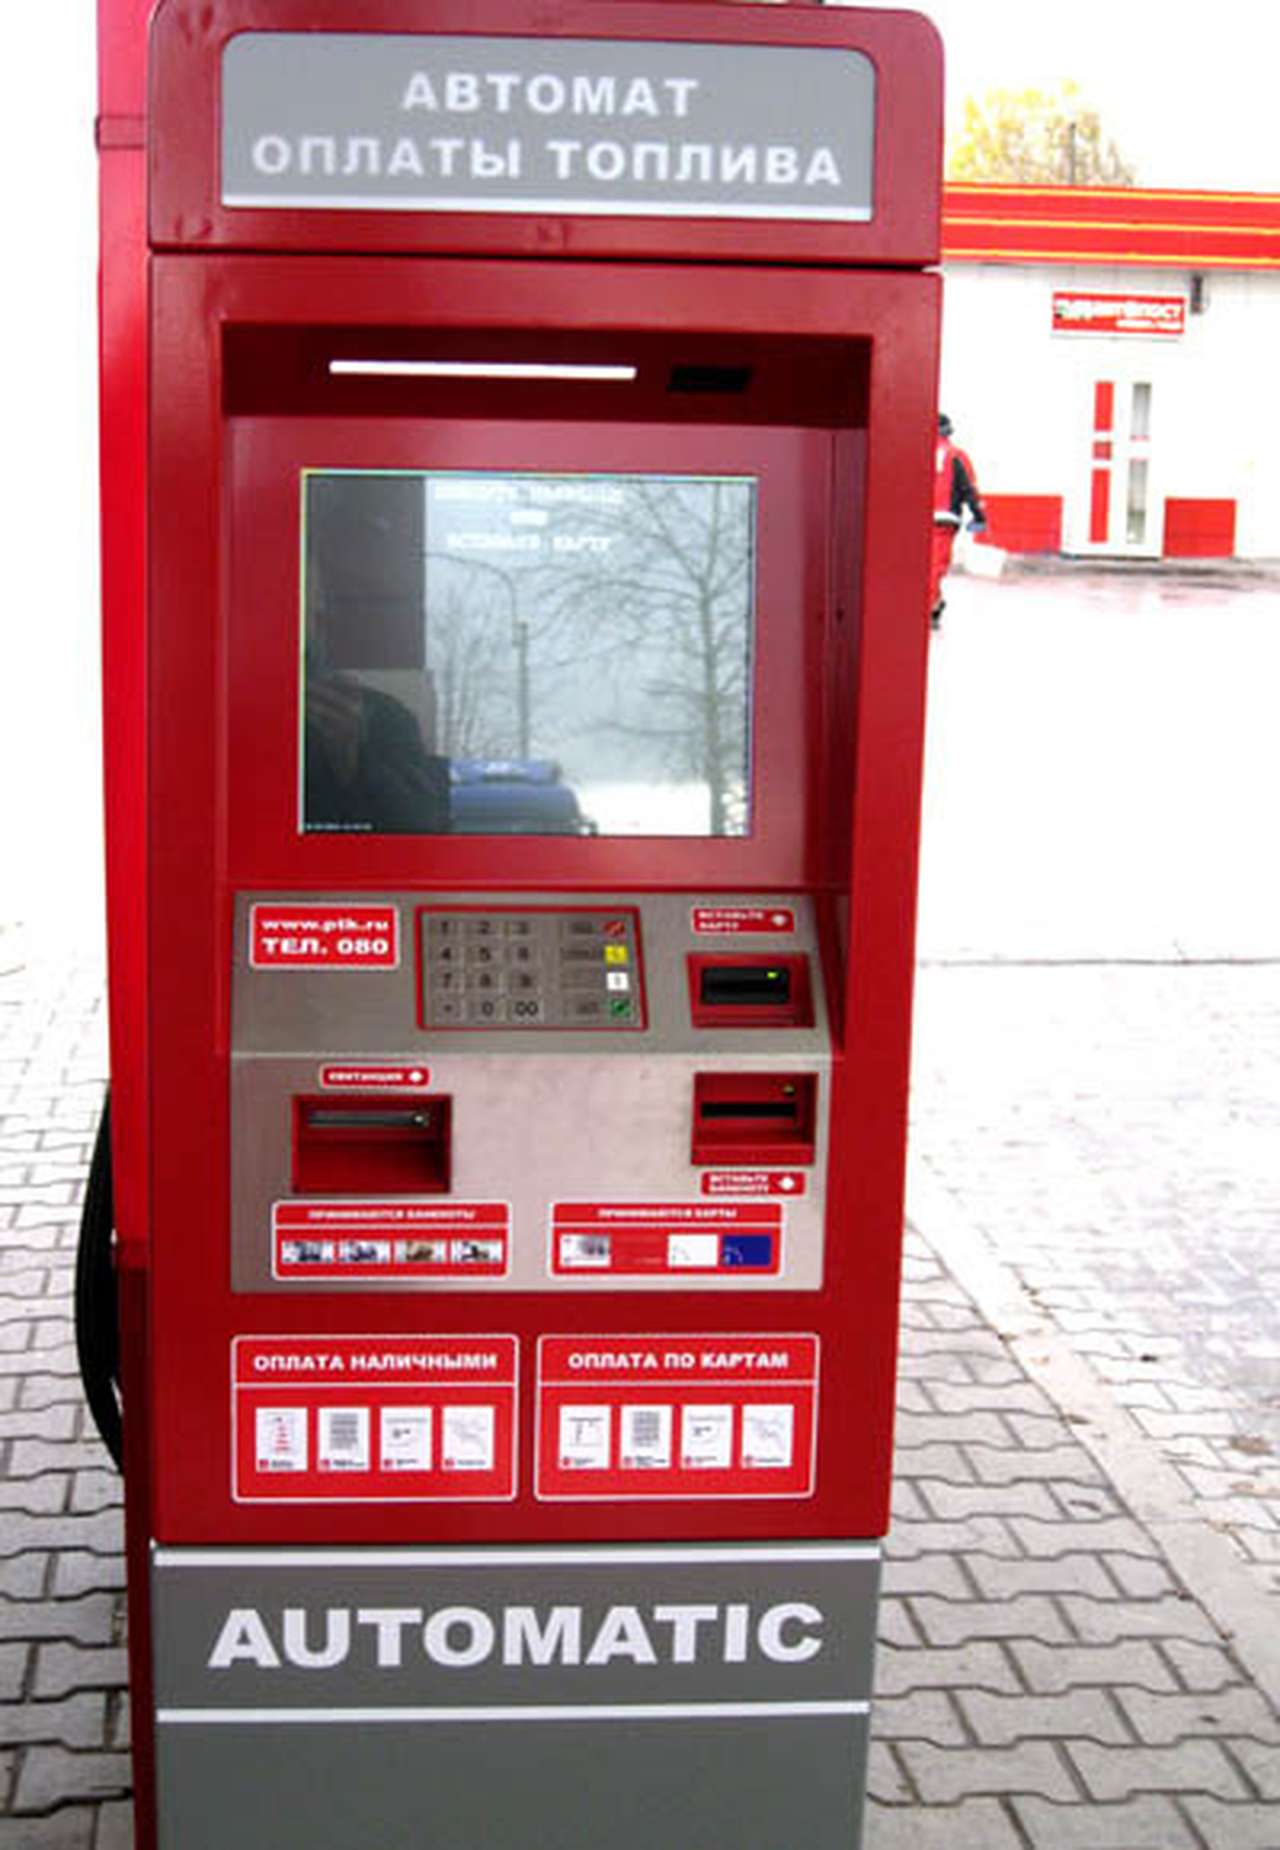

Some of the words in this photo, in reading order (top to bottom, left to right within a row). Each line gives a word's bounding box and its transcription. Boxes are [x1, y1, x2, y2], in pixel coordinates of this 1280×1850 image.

[402, 71, 699, 117] АВТОМАТ
[251, 133, 522, 177] ОПЛАТЫ
[547, 140, 842, 186] ТОПЛИВА
[261, 919, 388, 935] www.ptk.ru
[262, 938, 328, 956] ТЕЛ.
[337, 938, 388, 955] 080
[514, 1002, 539, 1016] 00
[253, 1354, 345, 1372] ОПЛАТА
[350, 1353, 498, 1371] НАЛИЧНЫМИ
[568, 1353, 658, 1369] ОПЛАТА
[664, 1353, 695, 1368] ПО
[701, 1352, 789, 1369] КАРТАМ
[207, 1602, 823, 1669] AUTOMATIC
